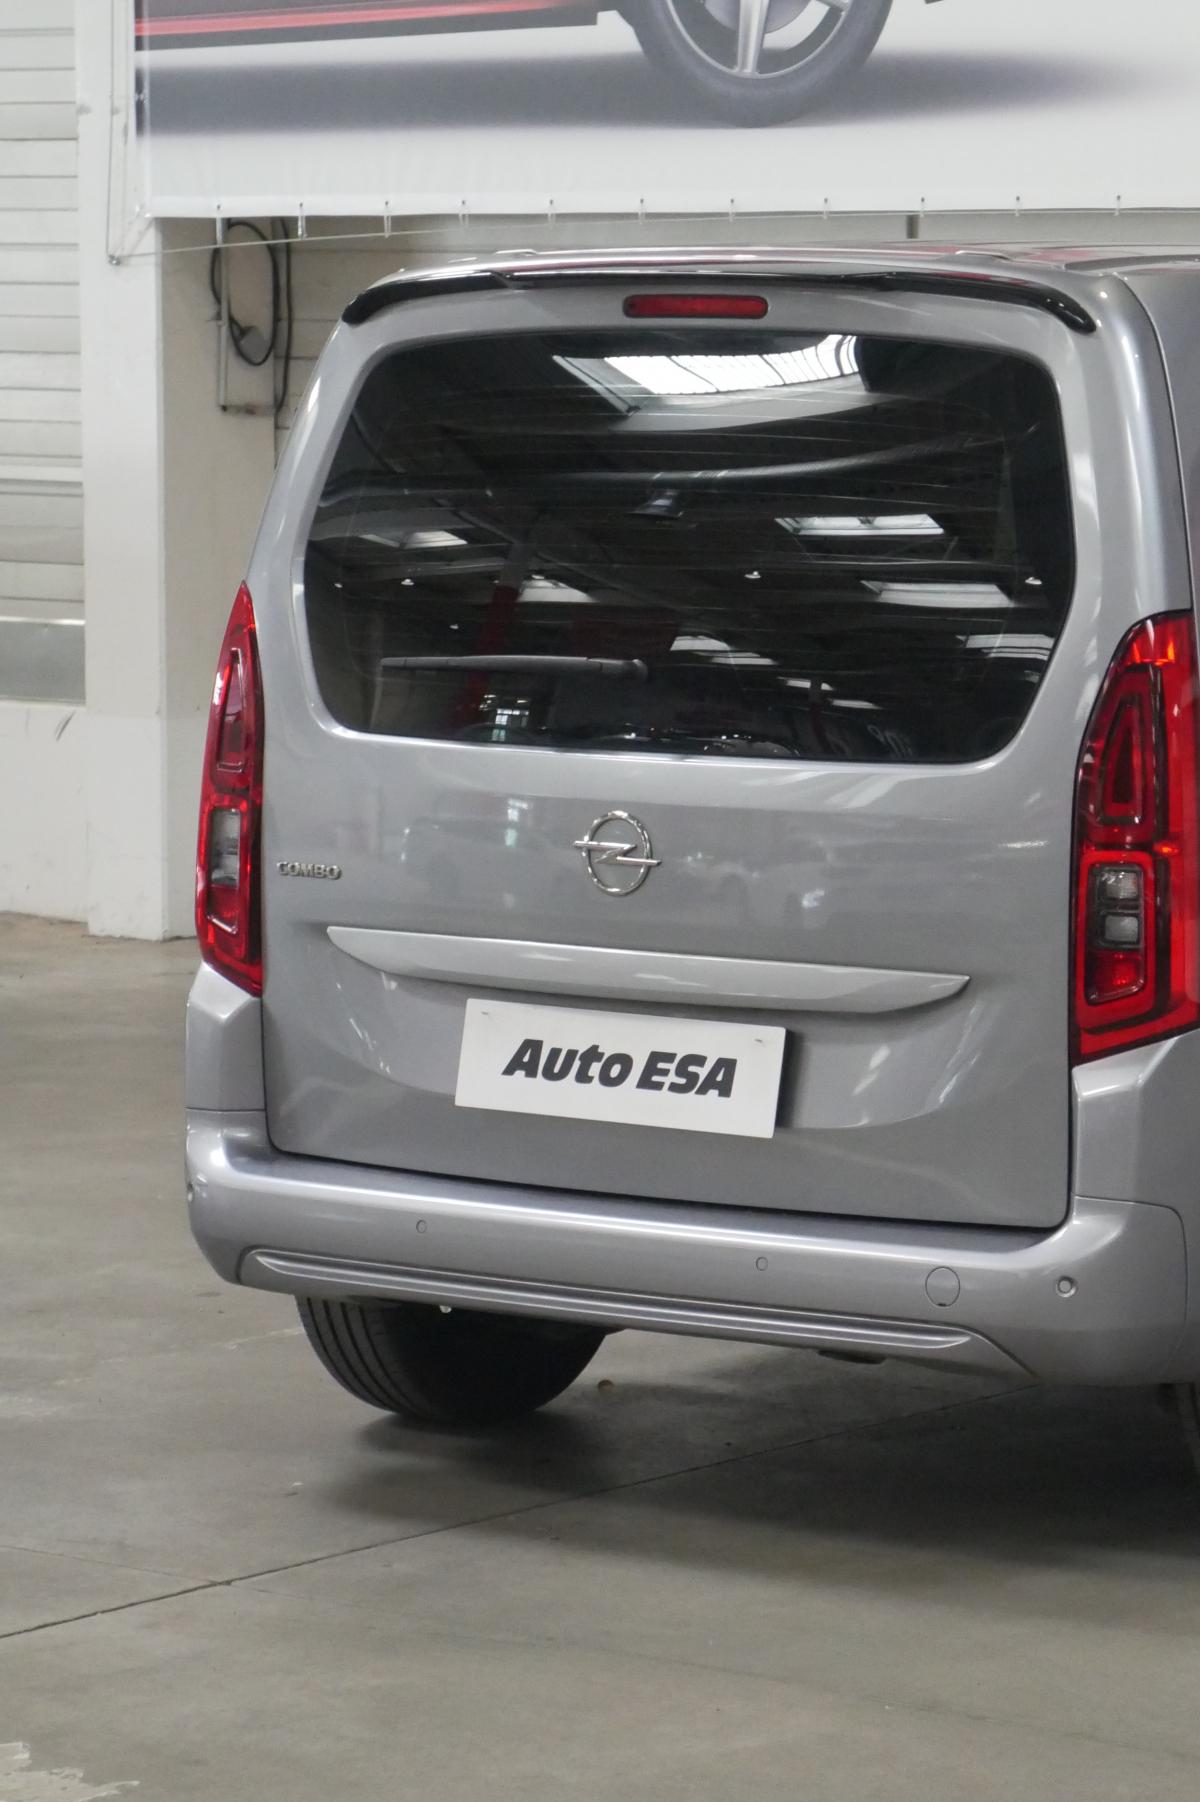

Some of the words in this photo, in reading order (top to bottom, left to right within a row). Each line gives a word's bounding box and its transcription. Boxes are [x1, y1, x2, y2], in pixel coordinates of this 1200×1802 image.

[277, 861, 342, 880] COMBO
[501, 1038, 634, 1088] Auto
[635, 1050, 737, 1098] ESA
